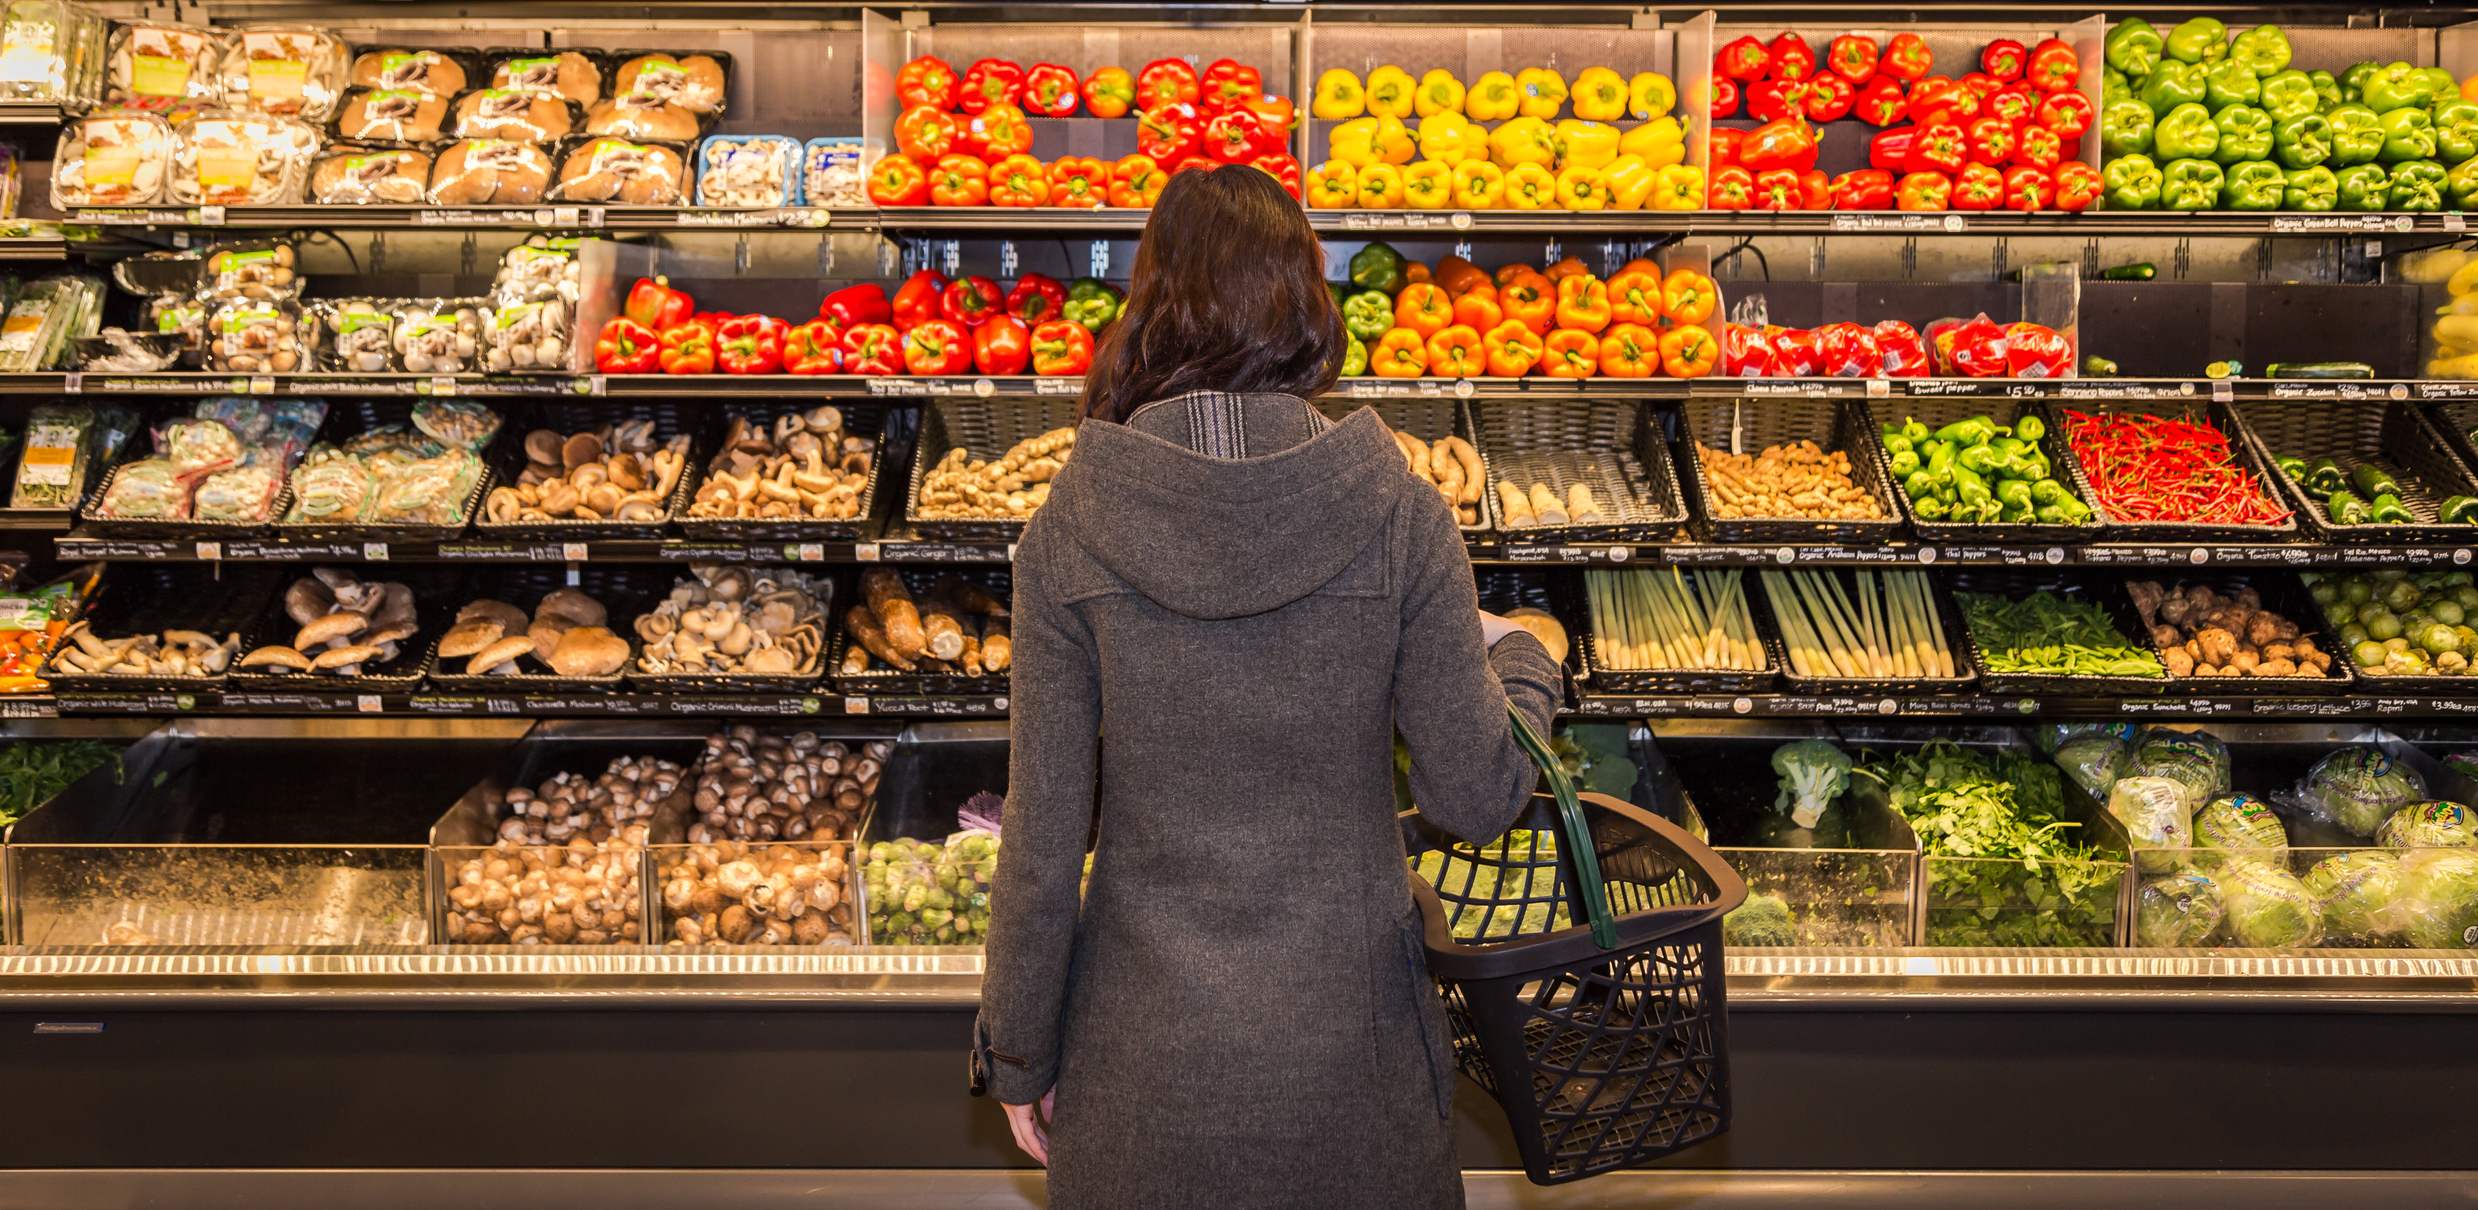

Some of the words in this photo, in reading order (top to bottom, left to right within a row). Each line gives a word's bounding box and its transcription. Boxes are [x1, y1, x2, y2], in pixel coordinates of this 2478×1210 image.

[679, 212, 706, 224] Sliced
[1370, 218, 1381, 226] Bell
[2274, 218, 2303, 230] Organic
[872, 386, 885, 394] Red
[887, 386, 900, 394] Bell
[1036, 386, 1056, 394] Green
[1058, 386, 1070, 394] Bell
[1353, 386, 1374, 396] Orange
[2274, 388, 2303, 399] Organic
[2422, 390, 2447, 400] Organic
[660, 549, 690, 560] Organic
[883, 549, 919, 561] Organic
[920, 549, 949, 561] Ginger
[1798, 550, 1824, 561] Organic
[1945, 550, 1960, 559] Thai
[1962, 551, 1987, 560] Peppers
[2216, 551, 2243, 563] Organic
[57, 700, 88, 711] Organic
[670, 702, 707, 713] Organic
[735, 703, 778, 712] Mushrooms
[874, 702, 905, 714] Yucca
[906, 702, 930, 713] Root
[1815, 702, 1833, 712] Peas
[1909, 701, 1929, 711] Mung
[1931, 701, 1949, 709] Bean
[2121, 703, 2150, 713] Organic
[2152, 703, 2188, 711] Sunchoke
[2252, 702, 2286, 715] Organic
[2286, 701, 2318, 714] Iceberg
[2318, 701, 2352, 712] Lettuce
